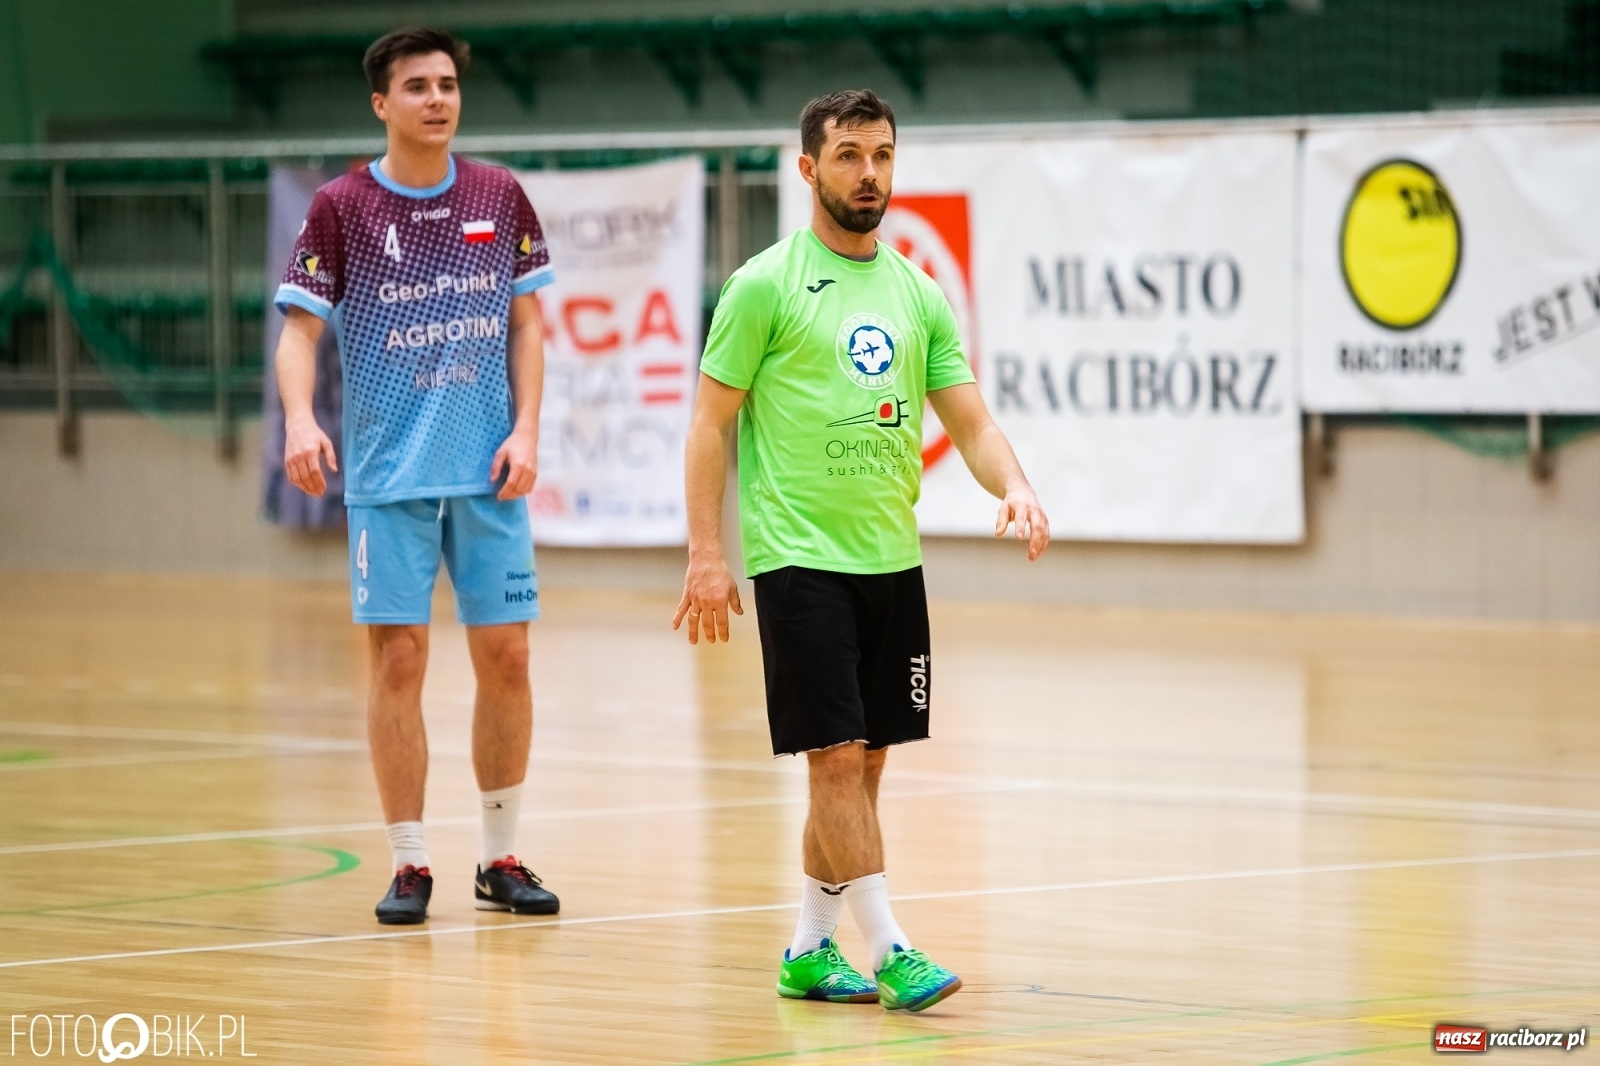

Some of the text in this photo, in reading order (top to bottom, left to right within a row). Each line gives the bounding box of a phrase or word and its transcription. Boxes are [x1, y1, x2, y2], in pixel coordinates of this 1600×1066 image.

[383, 223, 401, 262] 4
[378, 270, 497, 304] Geo-Punkt
[1024, 252, 1242, 319] MIASTO
[386, 316, 500, 350] AGROTIM
[840, 315, 901, 344] FOOTBALL
[1493, 283, 1574, 361] JEST
[414, 364, 479, 391] KIETRZ
[848, 366, 896, 386] MANIAC
[995, 332, 1283, 417] RACIBÓRZ
[827, 464, 873, 476] sushi
[879, 464, 887, 475] &
[356, 528, 369, 580] 4
